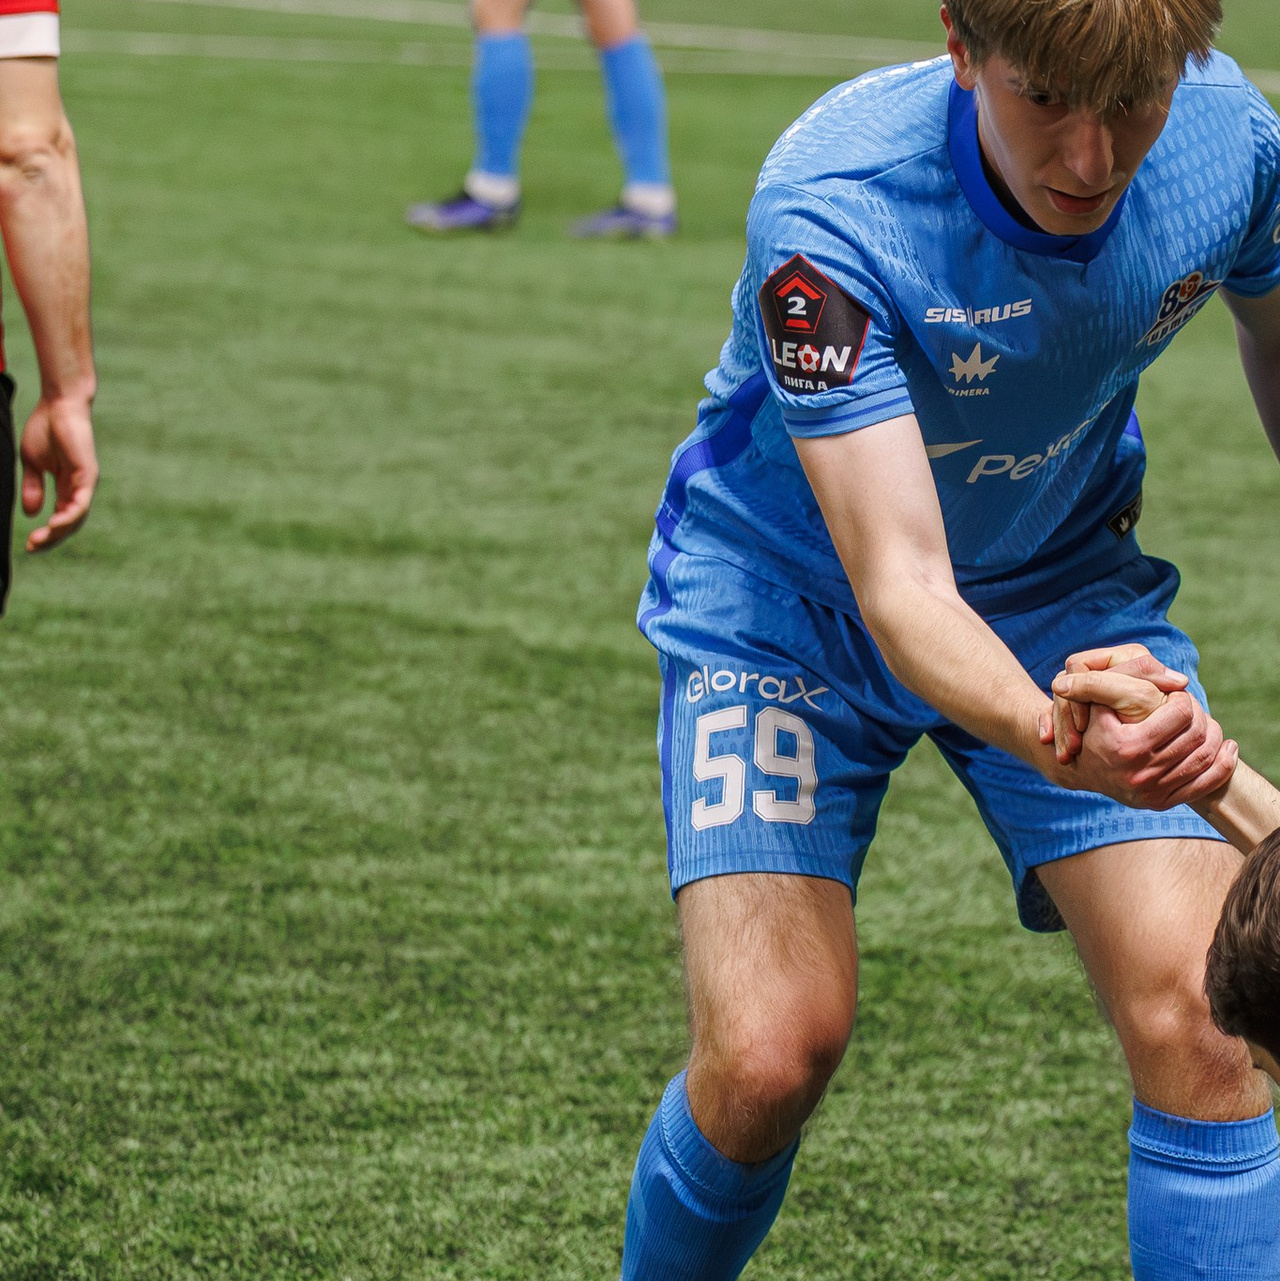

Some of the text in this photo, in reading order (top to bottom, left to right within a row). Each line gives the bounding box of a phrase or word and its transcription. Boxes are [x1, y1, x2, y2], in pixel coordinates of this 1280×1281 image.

[787, 296, 807, 316] 2
[771, 338, 852, 373] LEON
[691, 704, 820, 832] 59
